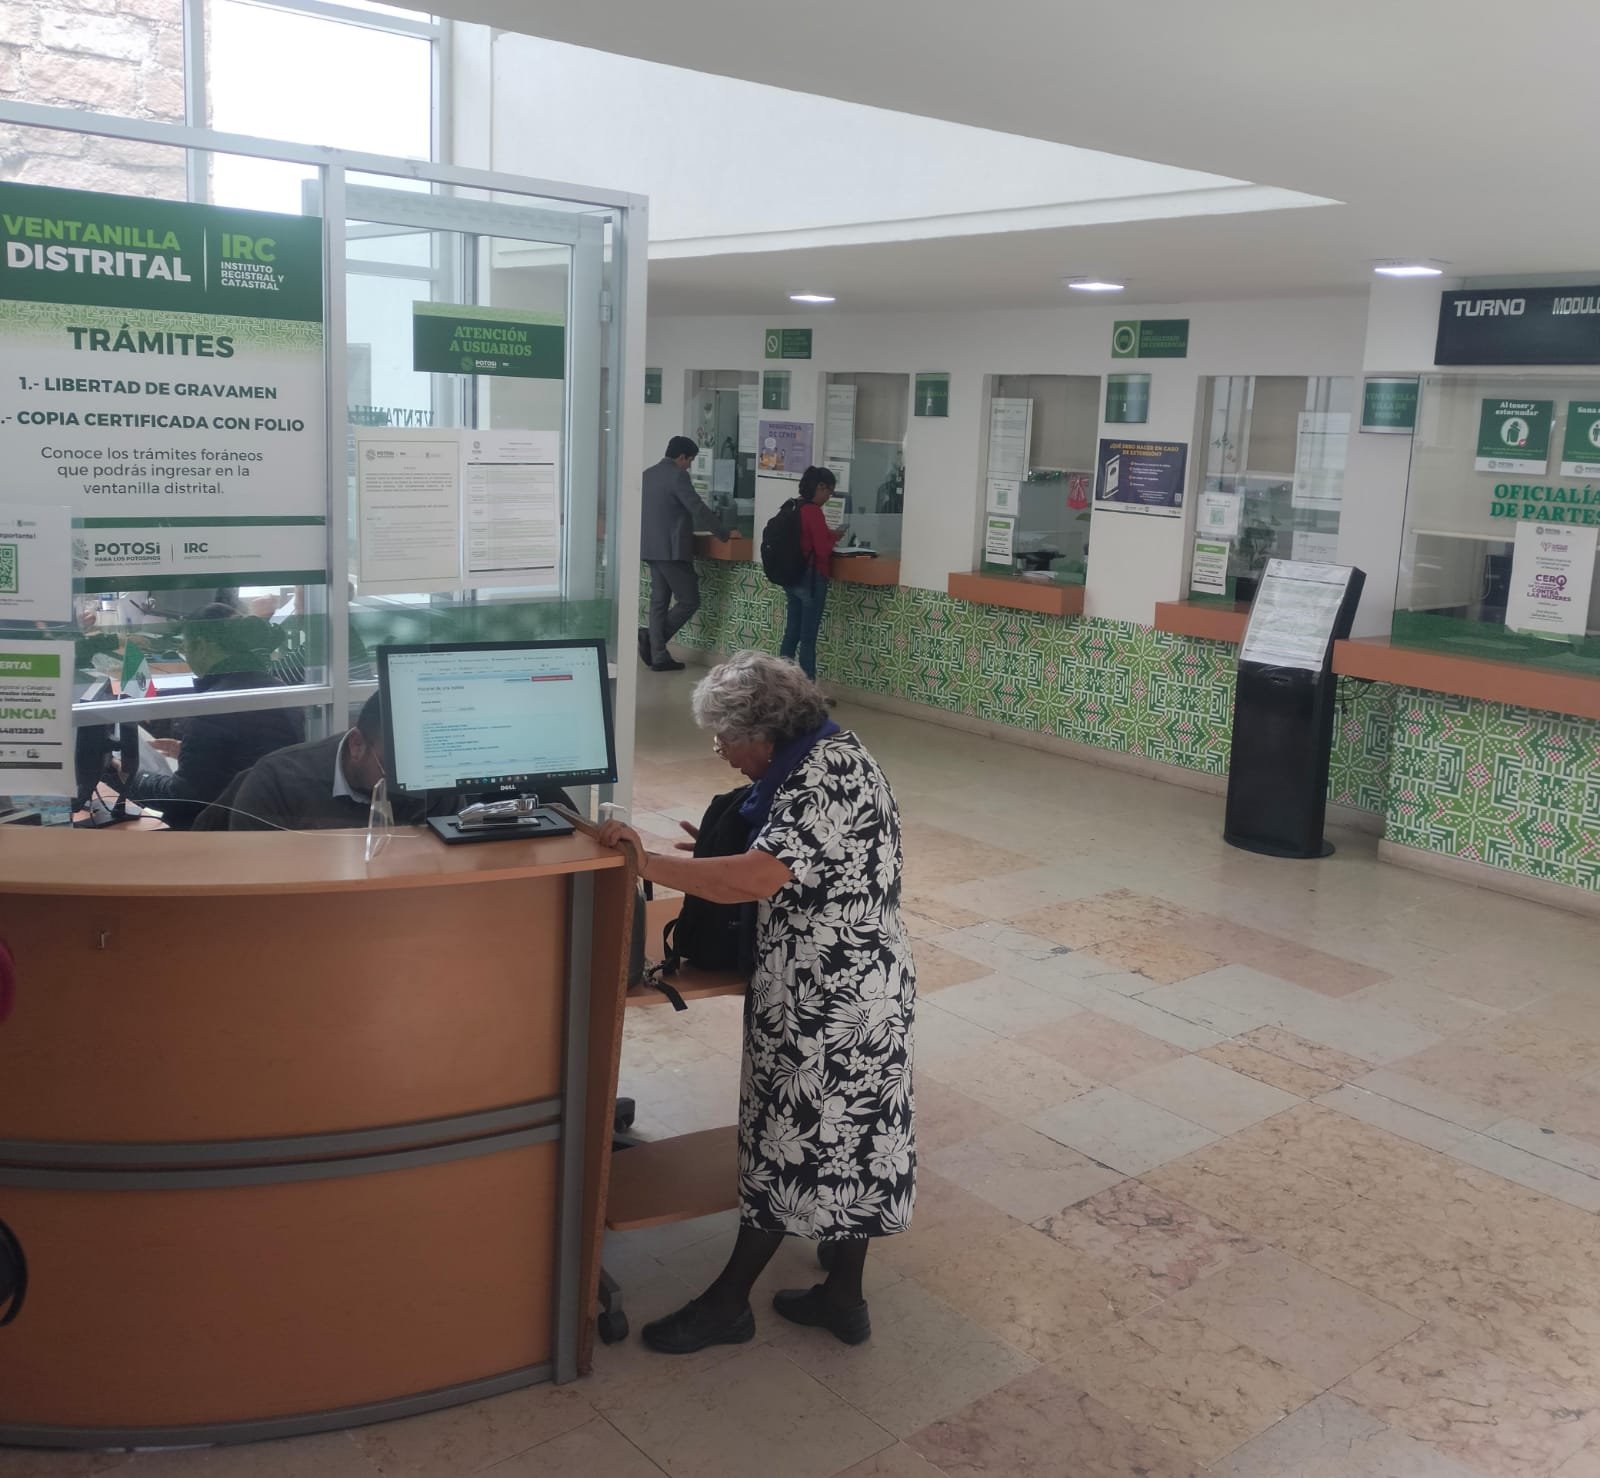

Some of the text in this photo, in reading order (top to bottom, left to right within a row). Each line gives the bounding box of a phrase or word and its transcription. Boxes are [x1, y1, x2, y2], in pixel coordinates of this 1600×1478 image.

[3, 214, 181, 251] VENTANILLA
[222, 233, 277, 262] IRC
[7, 241, 191, 282] DISTRITAL
[221, 261, 273, 273] INSTITUTO
[221, 270, 285, 283] REGISTRAL Y
[221, 279, 280, 291] CATASTRAL
[1454, 299, 1526, 317] TURNO
[67, 324, 234, 358] TRÁMITES
[454, 325, 528, 342] ATENCIÓN
[449, 340, 533, 357] A USUARIOS
[18, 376, 278, 400] 1.- LIBERTAD DE GRAVAMEN
[17, 411, 80, 426] COPIA
[84, 413, 209, 429] CERTIFICADA
[212, 416, 250, 430] CON
[254, 417, 305, 432] FOLIO
[41, 446, 264, 461] Conoce los trámites foráneos
[57, 463, 250, 479] que podrás ingresar en la
[83, 482, 225, 494] ventanilla distrital.
[1494, 484, 1600, 505] OFICIALÍA
[1490, 502, 1518, 518] DE
[184, 542, 208, 553] IRC
[0, 708, 56, 720] UNCIA!
